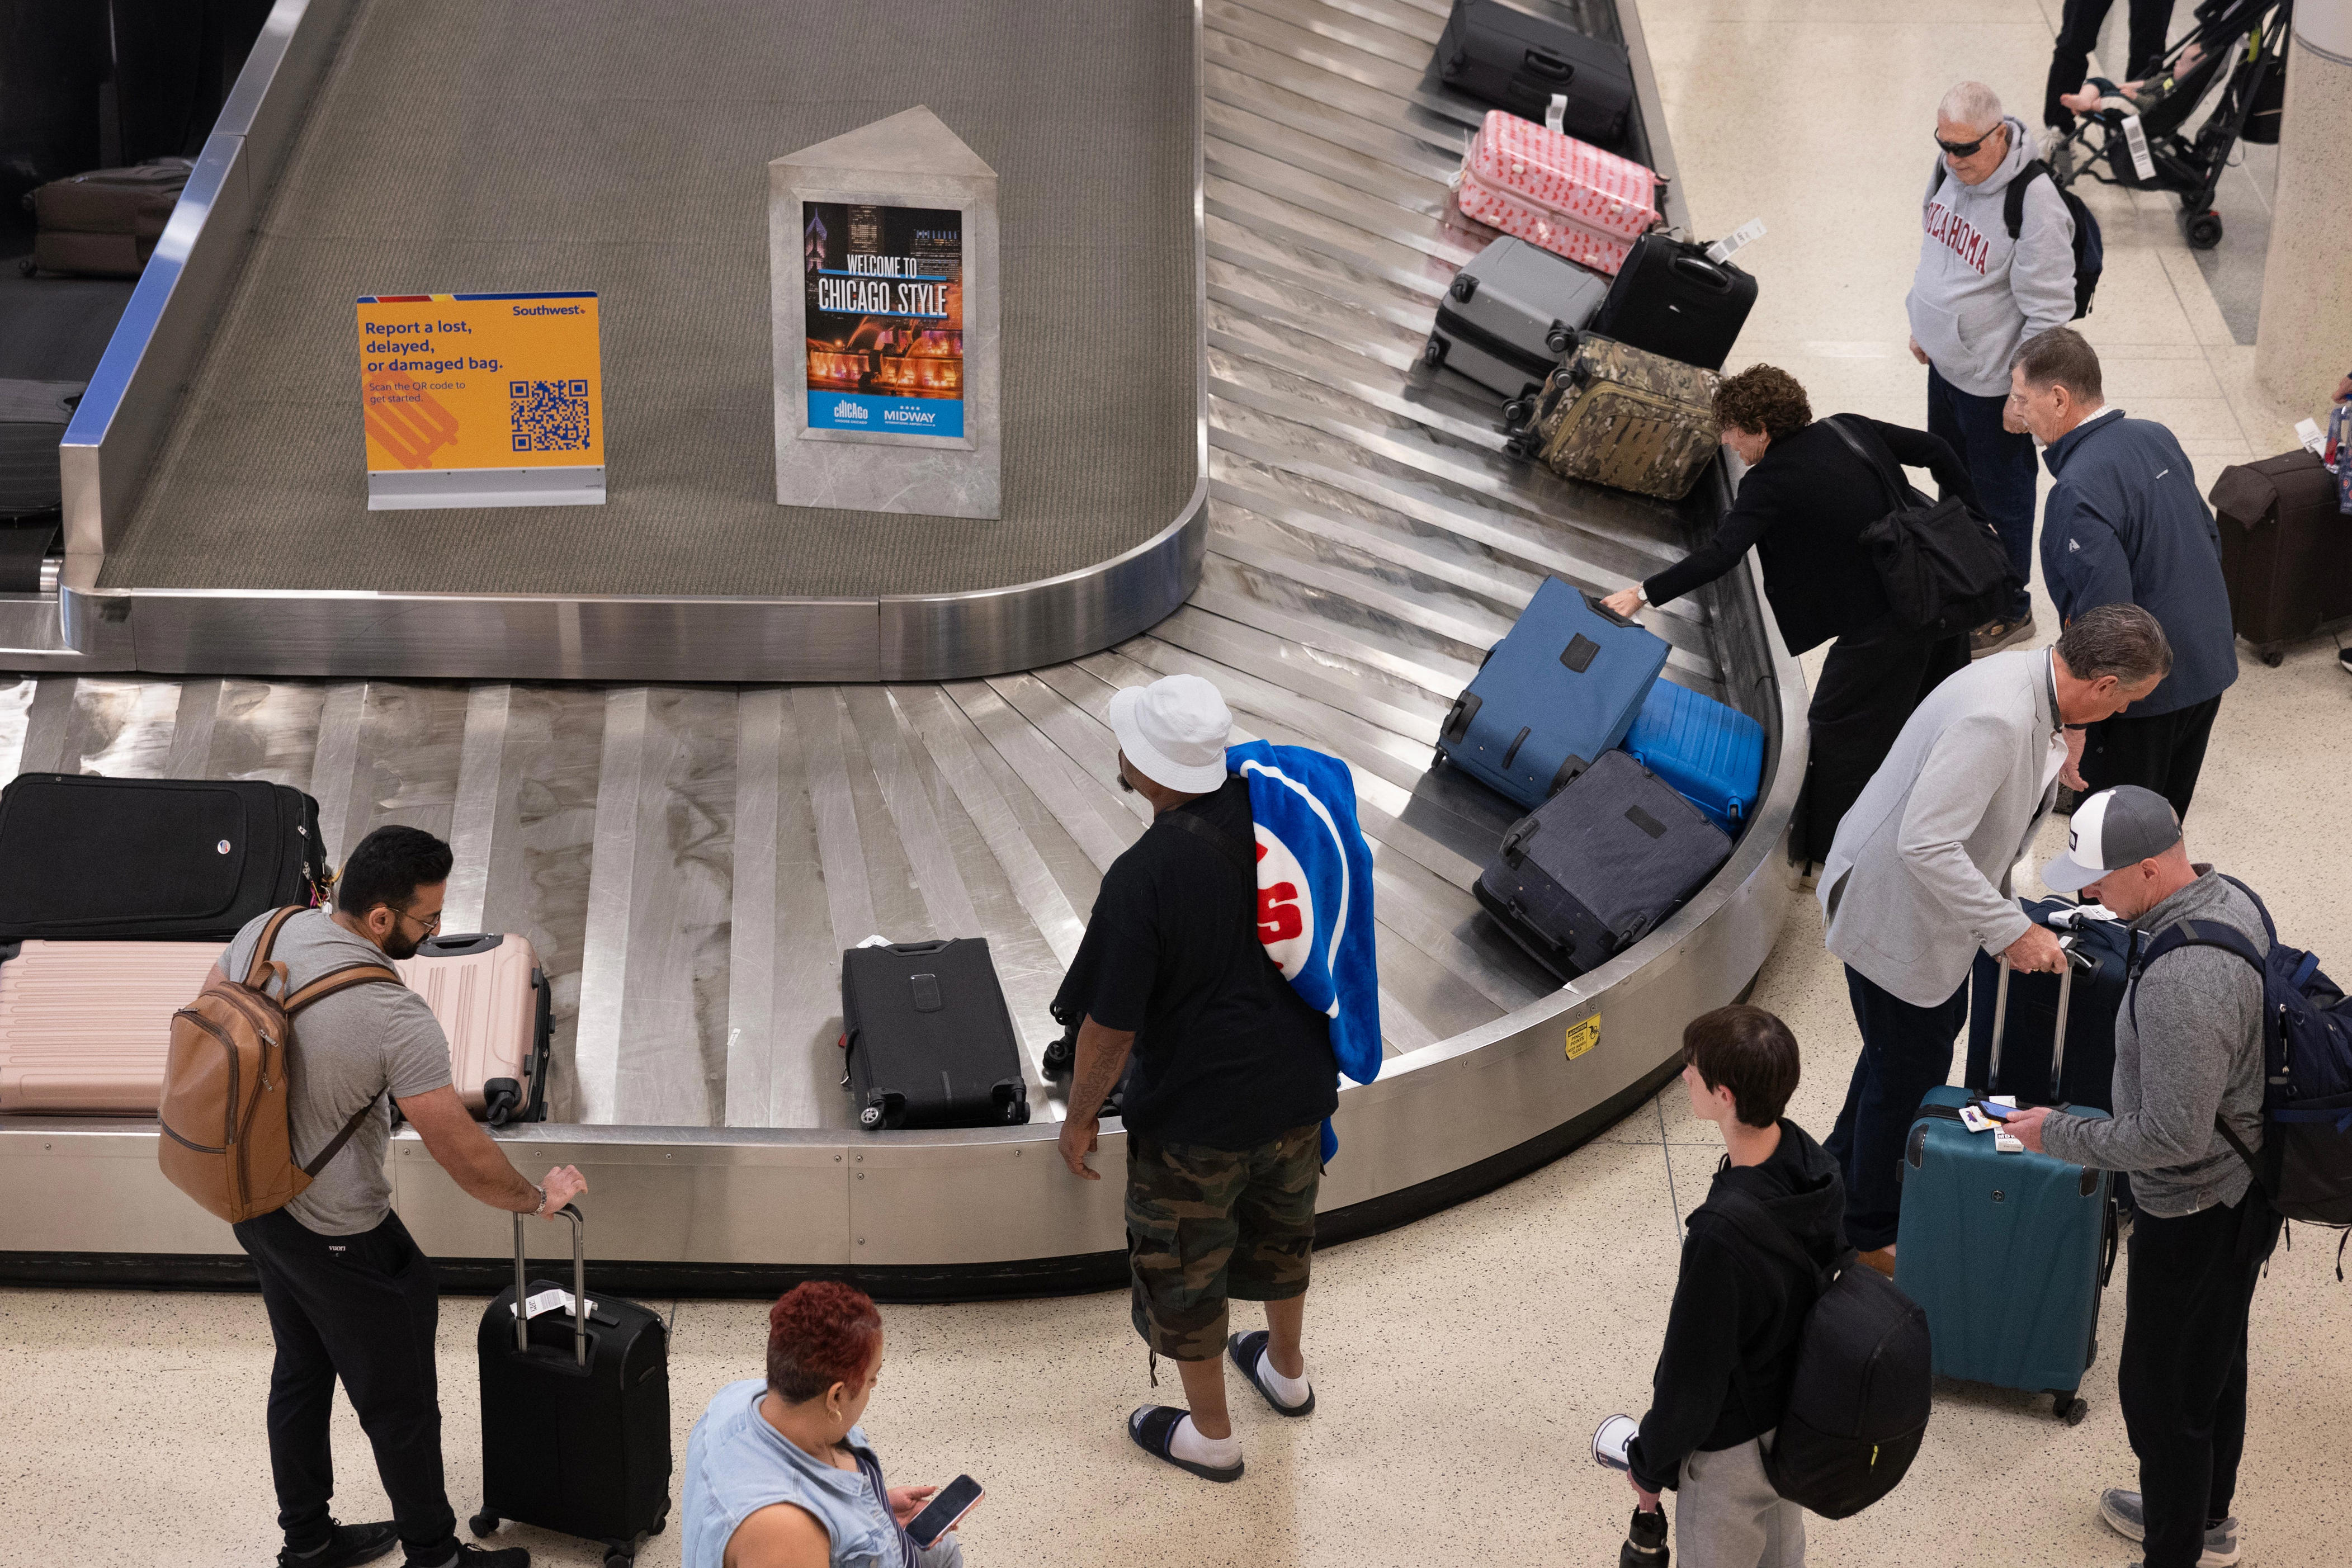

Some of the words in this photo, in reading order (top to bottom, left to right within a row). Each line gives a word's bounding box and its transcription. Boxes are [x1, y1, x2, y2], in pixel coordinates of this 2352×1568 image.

[847, 254, 901, 277] WELCOME
[903, 257, 917, 278] TO
[819, 278, 890, 313] CHICAGO
[898, 283, 947, 316] STYLE
[513, 305, 579, 316] Southwest
[366, 322, 420, 337] Report
[424, 324, 433, 333] a
[438, 320, 472, 334] lost,
[366, 339, 434, 356] delayed,
[367, 362, 384, 371] or
[389, 357, 463, 374] damaged
[469, 357, 503, 372] bag.
[413, 382, 427, 390] QR
[370, 396, 385, 405] get
[388, 394, 423, 403] started.
[884, 410, 936, 423] MIDWAY
[1570, 1036, 1584, 1047] POINTS
[1571, 1032, 1584, 1041] PINCH
